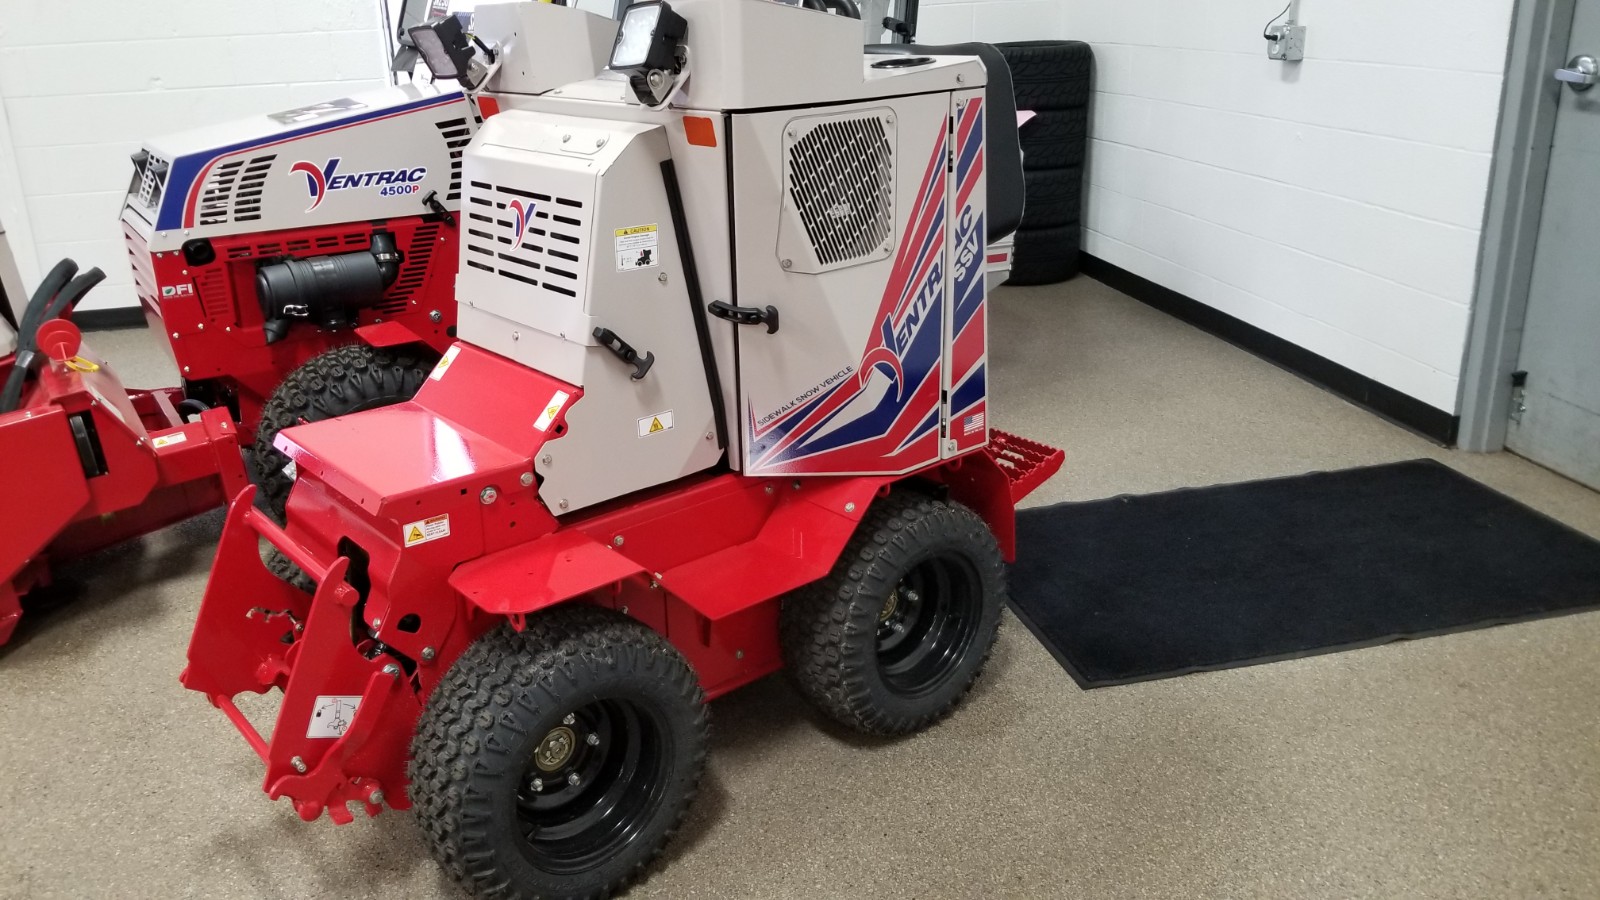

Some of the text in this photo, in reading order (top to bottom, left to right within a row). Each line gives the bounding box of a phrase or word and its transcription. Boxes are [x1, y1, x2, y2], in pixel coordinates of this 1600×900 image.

[289, 158, 427, 211] VENTRAC
[380, 185, 420, 196] 4500P
[953, 229, 979, 282] SSV
[161, 283, 194, 298] DFI
[756, 365, 854, 426] SIDEWALK SNOW VEHICLE
